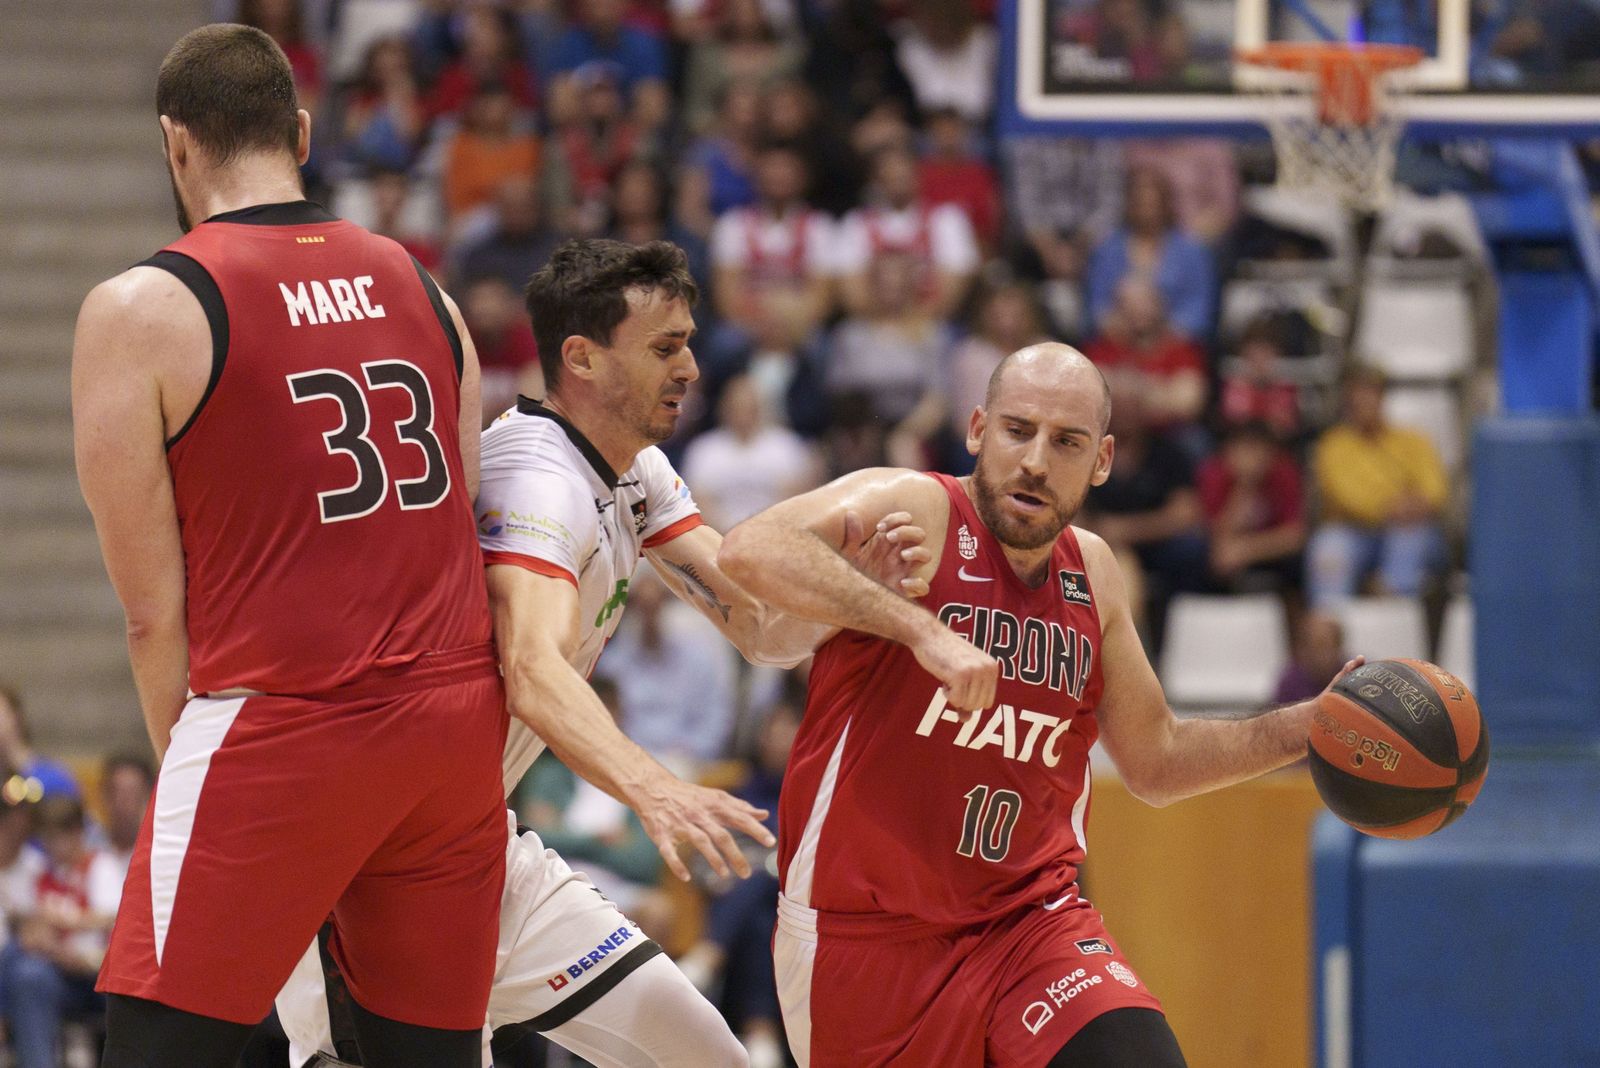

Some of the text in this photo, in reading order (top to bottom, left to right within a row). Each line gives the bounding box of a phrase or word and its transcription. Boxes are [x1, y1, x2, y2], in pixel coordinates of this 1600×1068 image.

[279, 275, 386, 326] MARC
[286, 359, 451, 524] 33
[1360, 737, 1401, 771] liga
[956, 784, 1022, 863] 10
[567, 926, 633, 979] BERNER
[1083, 942, 1106, 952] acb
[1045, 968, 1086, 999] Kave
[1053, 975, 1103, 1009] Home
